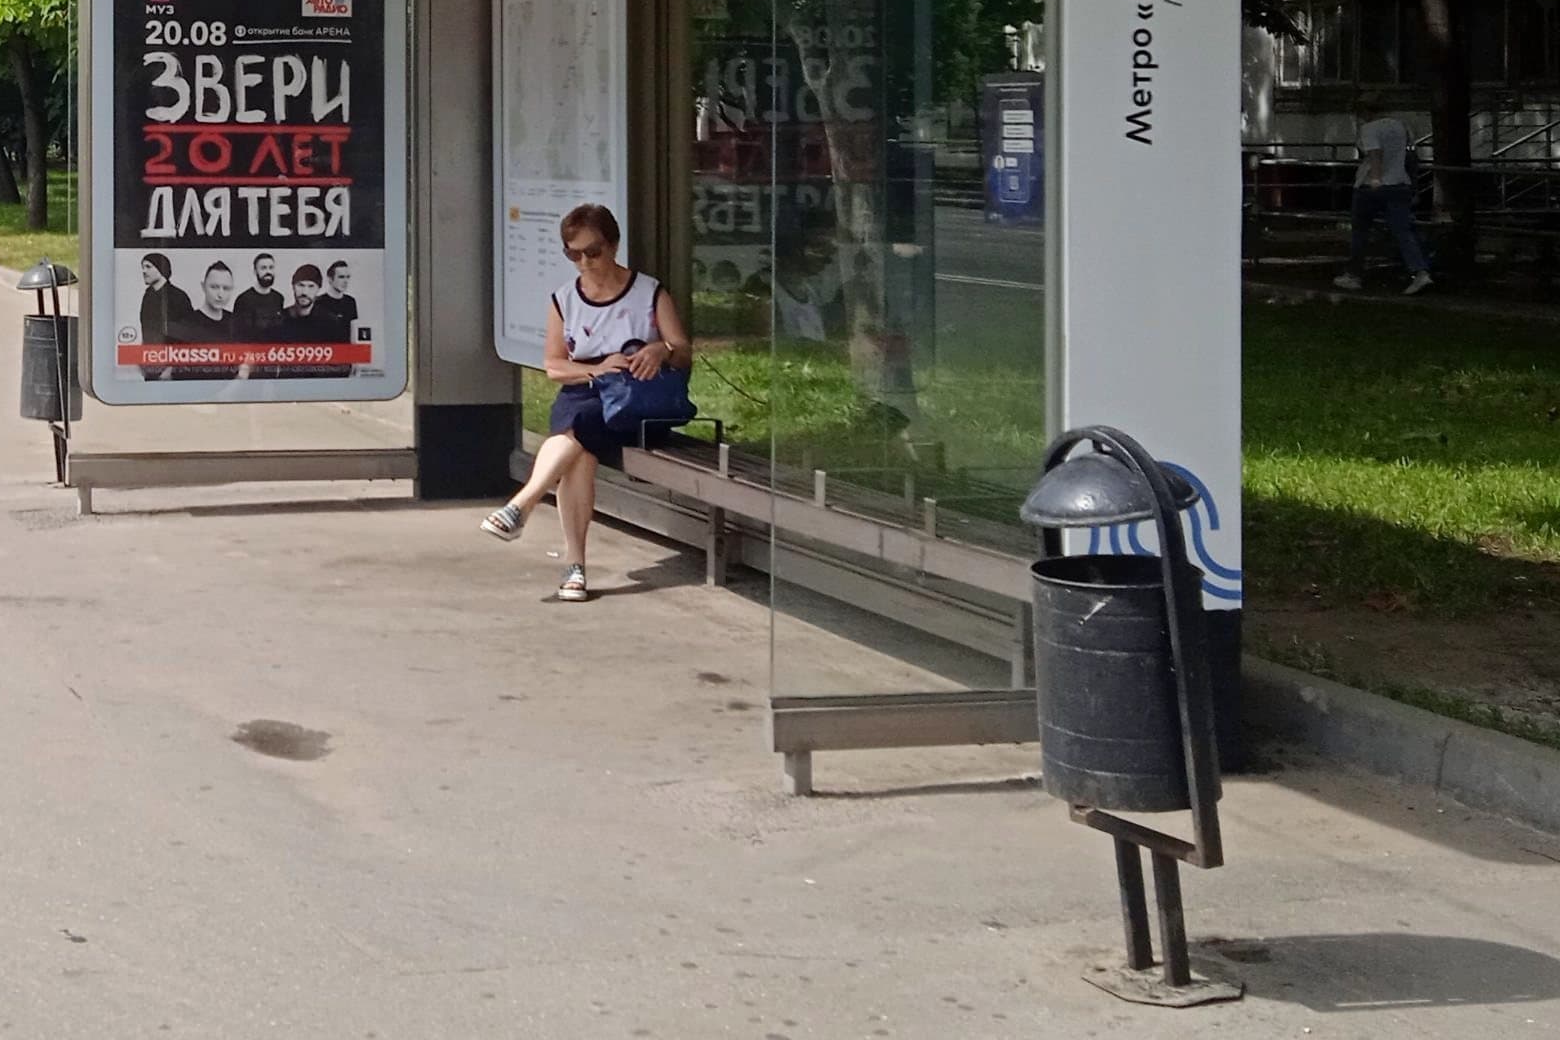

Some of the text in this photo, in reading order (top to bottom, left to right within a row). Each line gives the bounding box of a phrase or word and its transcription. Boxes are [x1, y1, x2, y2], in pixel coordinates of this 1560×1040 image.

[145, 4, 175, 16] МУЗ
[145, 20, 227, 46] 20.08
[247, 25, 351, 38] открытие банк АРЕНА
[143, 51, 351, 124] ЗВЕРИ
[1125, 28, 1159, 145] Метро
[143, 132, 351, 176] 20 ЛЕТ
[140, 185, 351, 239] ДЛЯ ТЕБЯ
[267, 346, 334, 362] 6659999
